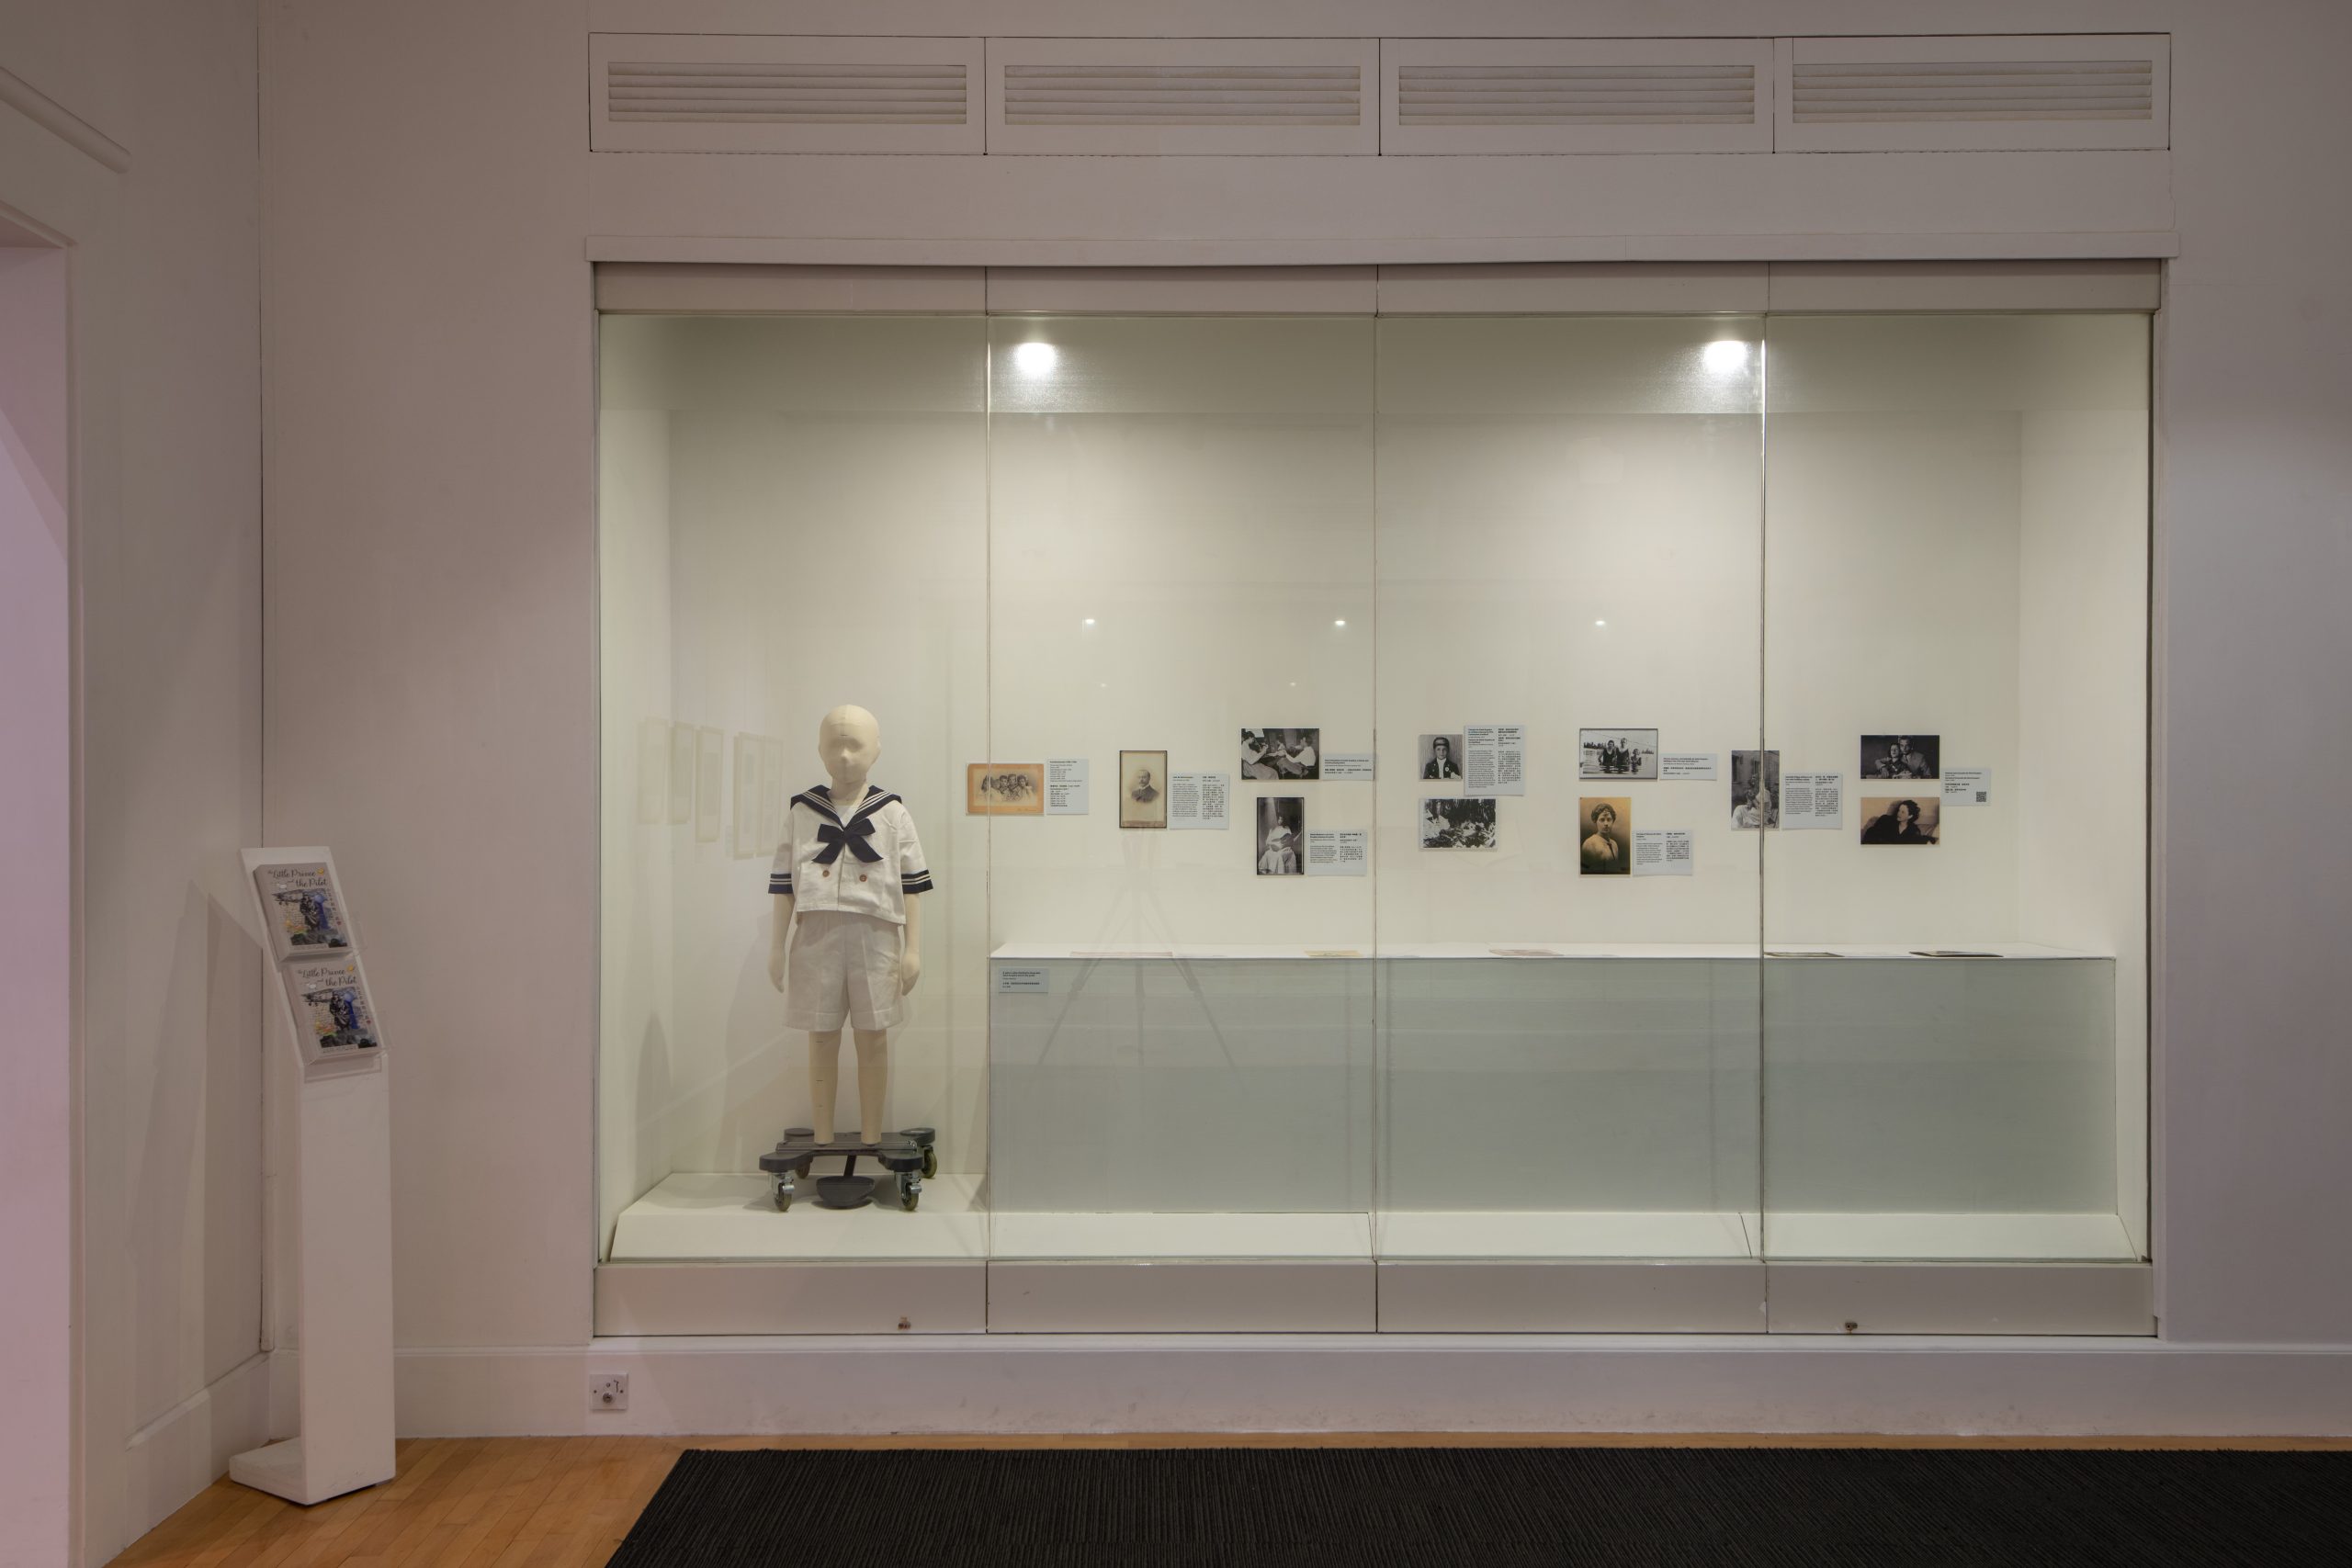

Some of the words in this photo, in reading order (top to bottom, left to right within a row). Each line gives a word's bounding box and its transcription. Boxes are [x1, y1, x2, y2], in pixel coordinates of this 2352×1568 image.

[274, 869, 288, 878] Little
[291, 869, 315, 877] Prince
[296, 879, 308, 887] the
[310, 878, 326, 886] Pilot
[302, 968, 320, 978] Little
[321, 967, 345, 976] Prince
[325, 977, 337, 986] the
[339, 976, 356, 986] Pilot
